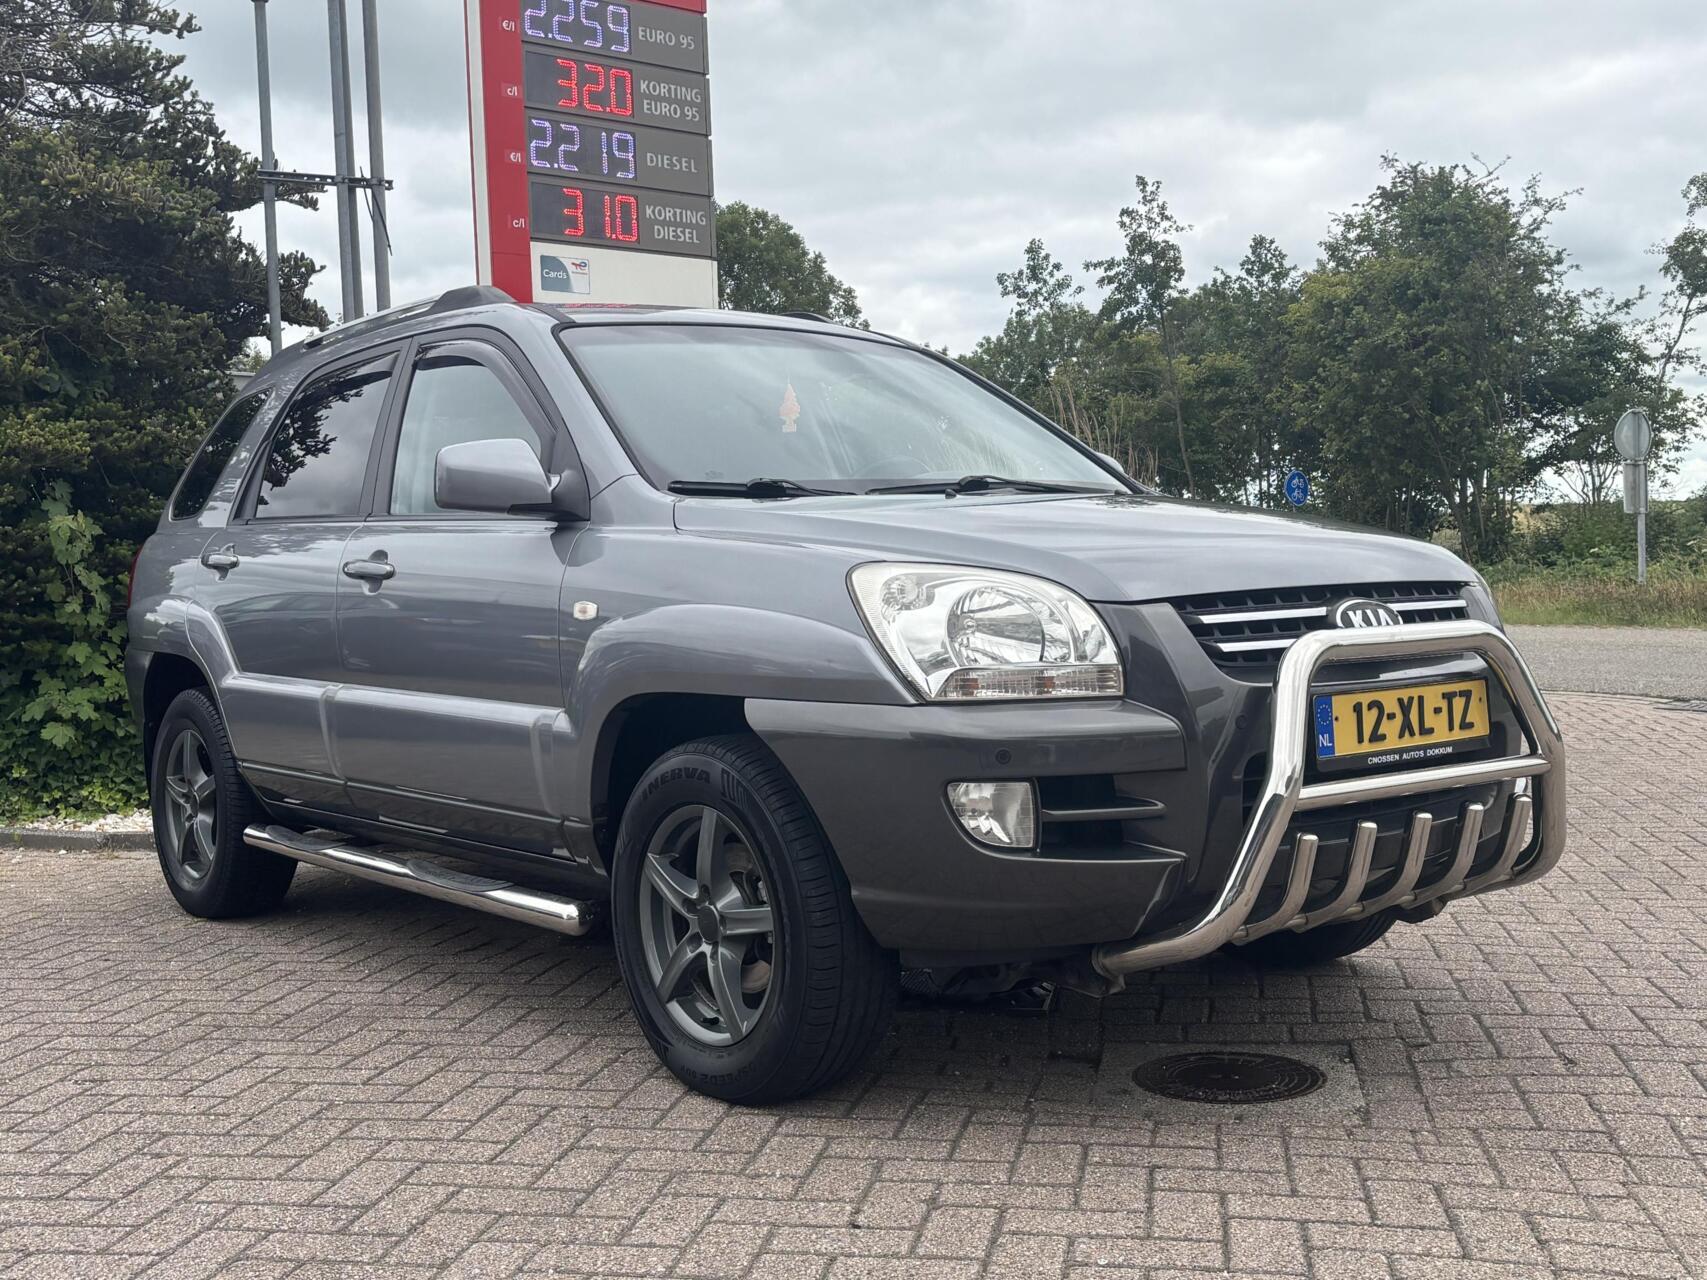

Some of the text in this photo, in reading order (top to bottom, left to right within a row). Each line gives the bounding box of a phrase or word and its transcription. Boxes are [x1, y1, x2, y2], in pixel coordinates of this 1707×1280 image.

[524, 0, 630, 52] 2.259
[638, 26, 695, 50] EURO 95
[557, 58, 633, 117] 32.0
[640, 79, 701, 103] KORTING
[643, 100, 700, 122] EURO 95
[646, 152, 698, 174] DIESEL
[563, 186, 639, 242] 31.0
[645, 204, 706, 226] KORTING
[654, 225, 701, 244] DIESEL
[543, 269, 567, 279] Cards
[1346, 608, 1394, 628] KIA
[1353, 689, 1475, 744] 12-XL-TZ
[1319, 734, 1332, 747] NL
[1368, 754, 1399, 765] CNOSSEN
[1427, 746, 1453, 758] DOKKUM
[639, 766, 711, 802] INERVA
